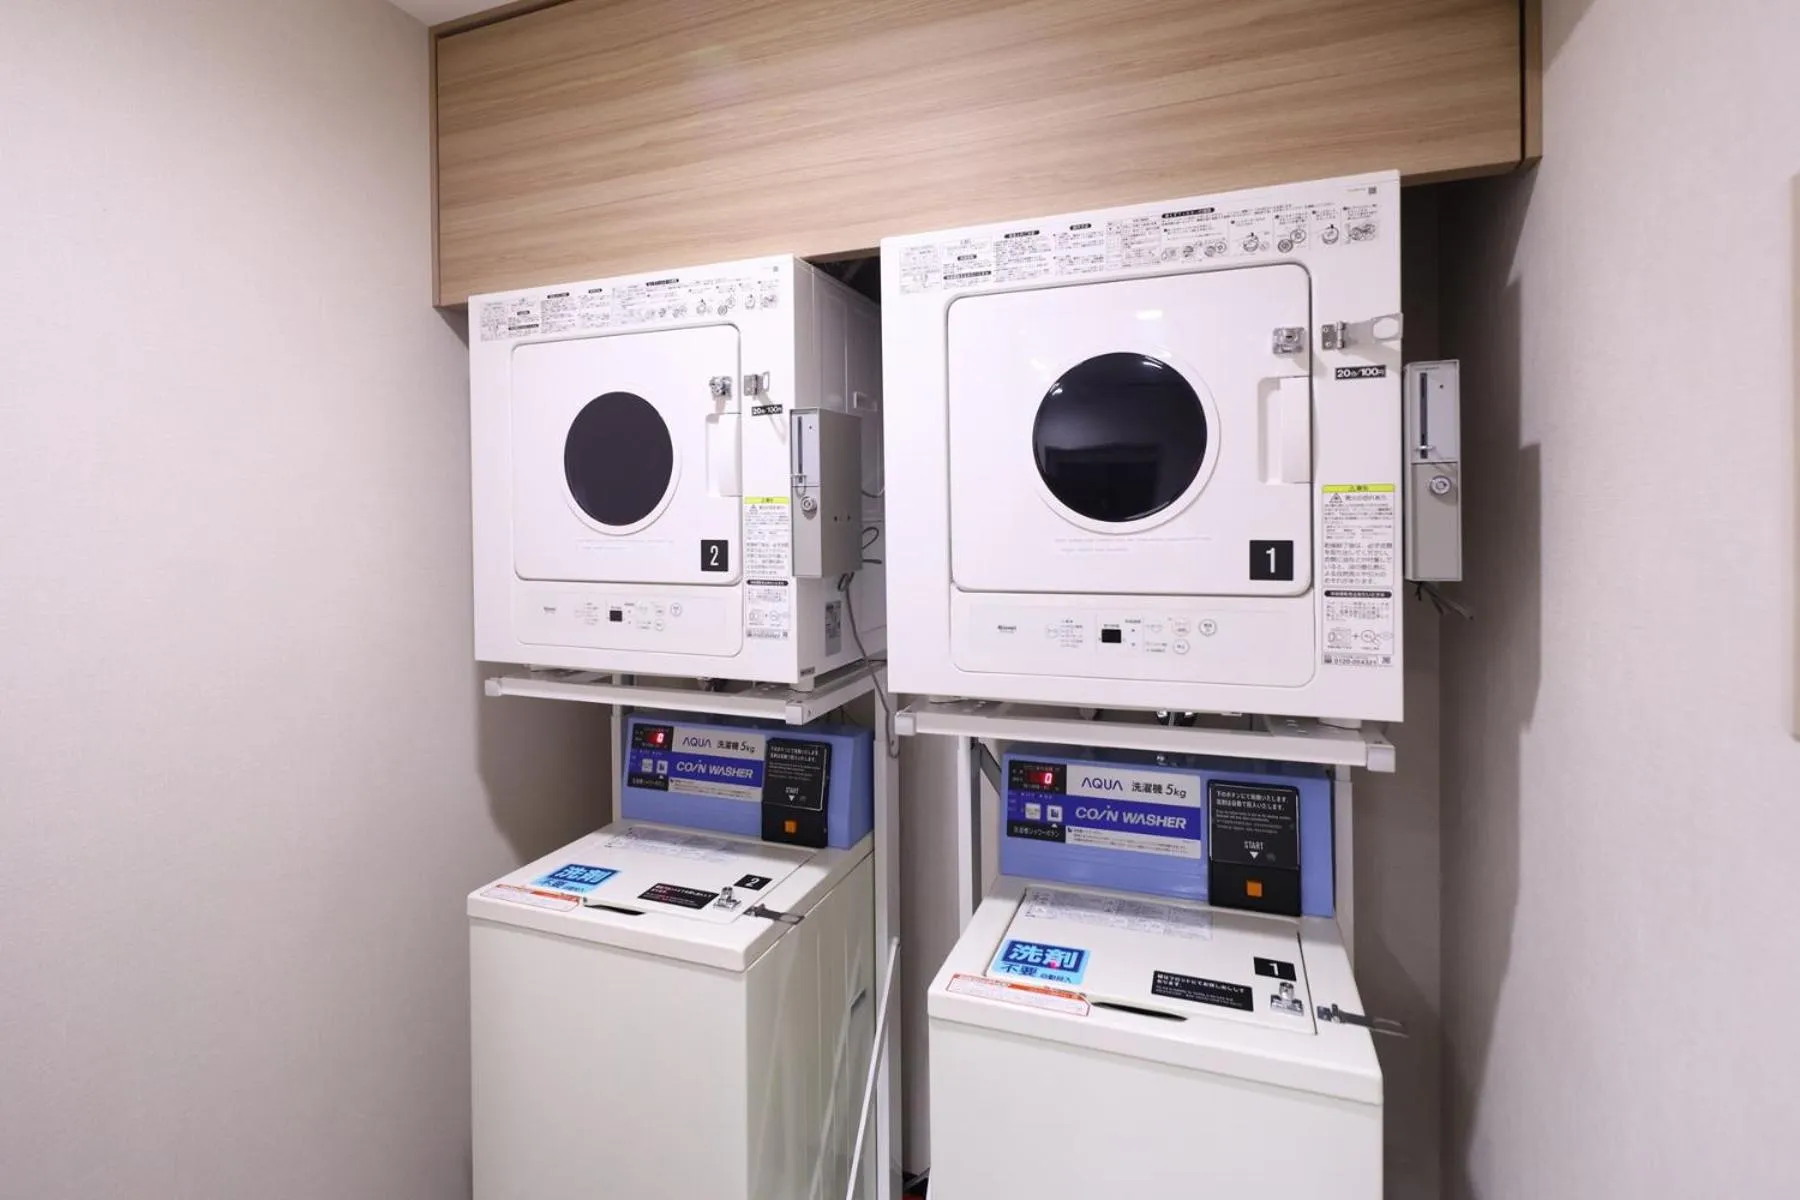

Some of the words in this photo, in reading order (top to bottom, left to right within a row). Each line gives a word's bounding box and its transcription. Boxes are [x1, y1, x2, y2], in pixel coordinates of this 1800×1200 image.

[710, 545, 719, 566] 2
[1266, 547, 1275, 573] 1
[682, 737, 712, 748] AQUA
[677, 760, 706, 773] COIN
[709, 764, 753, 779] WASHER
[1044, 772, 1053, 784] 0
[1081, 777, 1123, 791] AQUA
[1132, 781, 1163, 794] 洗濯機
[1165, 783, 1187, 799] 5kg
[1075, 805, 1119, 822] COIN
[1122, 812, 1187, 829] WASHER
[1243, 840, 1264, 850] START
[745, 877, 760, 888] 2
[1008, 943, 1079, 968] 洗剤
[1000, 964, 1038, 978] 不要
[1269, 963, 1279, 976] 1
